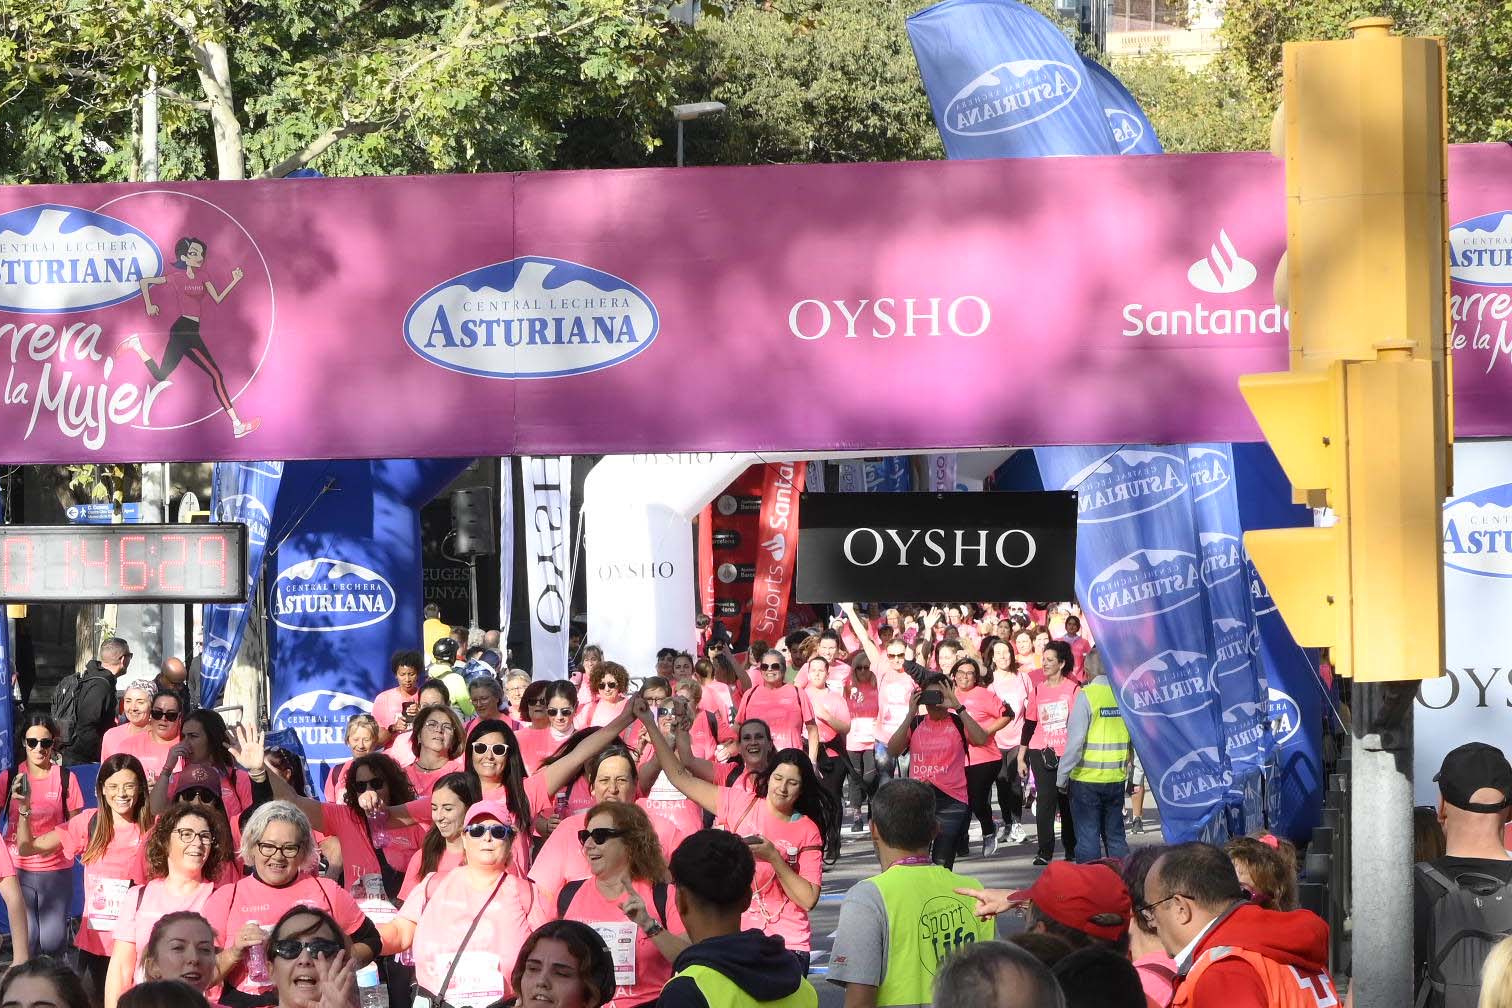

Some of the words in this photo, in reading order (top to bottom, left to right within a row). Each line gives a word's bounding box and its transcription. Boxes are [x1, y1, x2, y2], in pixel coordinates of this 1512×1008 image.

[462, 300, 541, 311] CENTRAL
[549, 297, 631, 310] LECHERA
[788, 296, 991, 339] OYSHO
[424, 304, 640, 348] ASTURIANA
[4, 364, 29, 404] la
[24, 356, 175, 450] Mujer
[843, 528, 1037, 568] OYSHO
[274, 590, 387, 615] ASTURIANA
[332, 583, 382, 591] LECHERA
[757, 565, 784, 634] Sports
[1416, 667, 1512, 710] OY
[287, 716, 329, 724] CENTRAL
[646, 800, 687, 810] DORSAL
[921, 904, 966, 940] Sport
